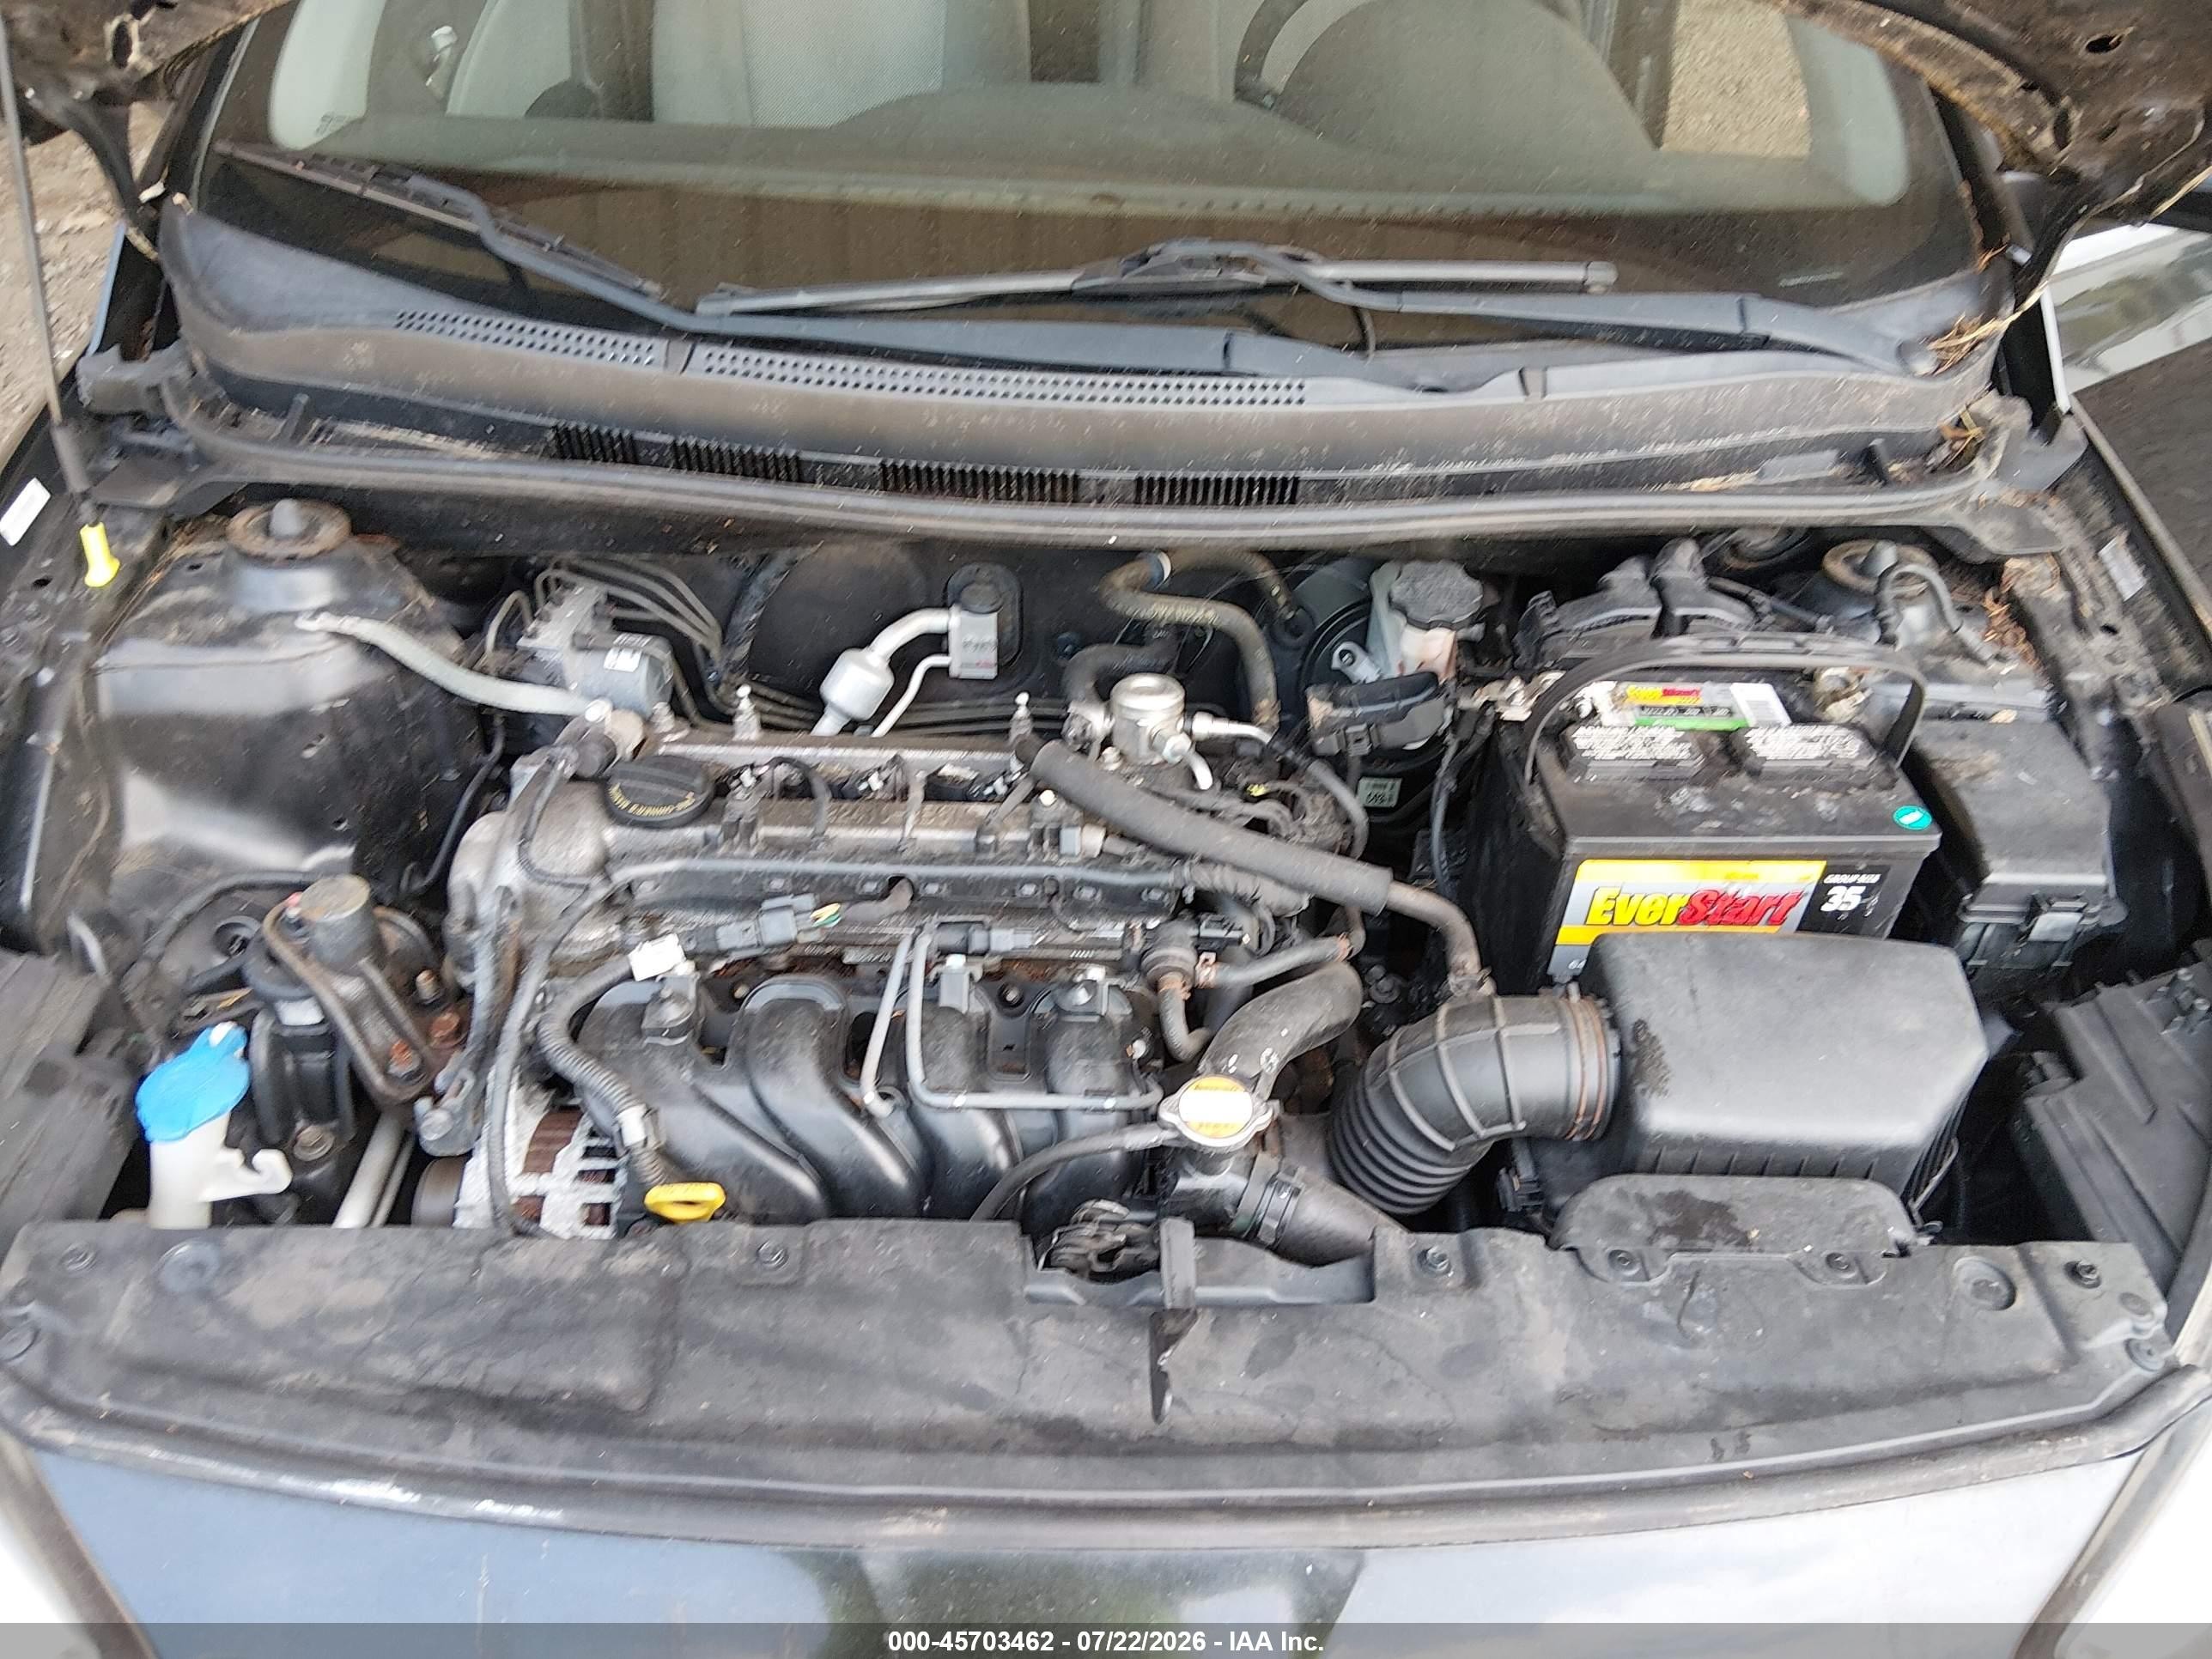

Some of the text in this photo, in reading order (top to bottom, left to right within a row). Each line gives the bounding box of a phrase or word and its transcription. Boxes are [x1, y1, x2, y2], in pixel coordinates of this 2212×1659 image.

[1824, 874, 1859, 884] GROUP
[1585, 885, 1806, 927] EverStart
[1820, 885, 1866, 912] 35
